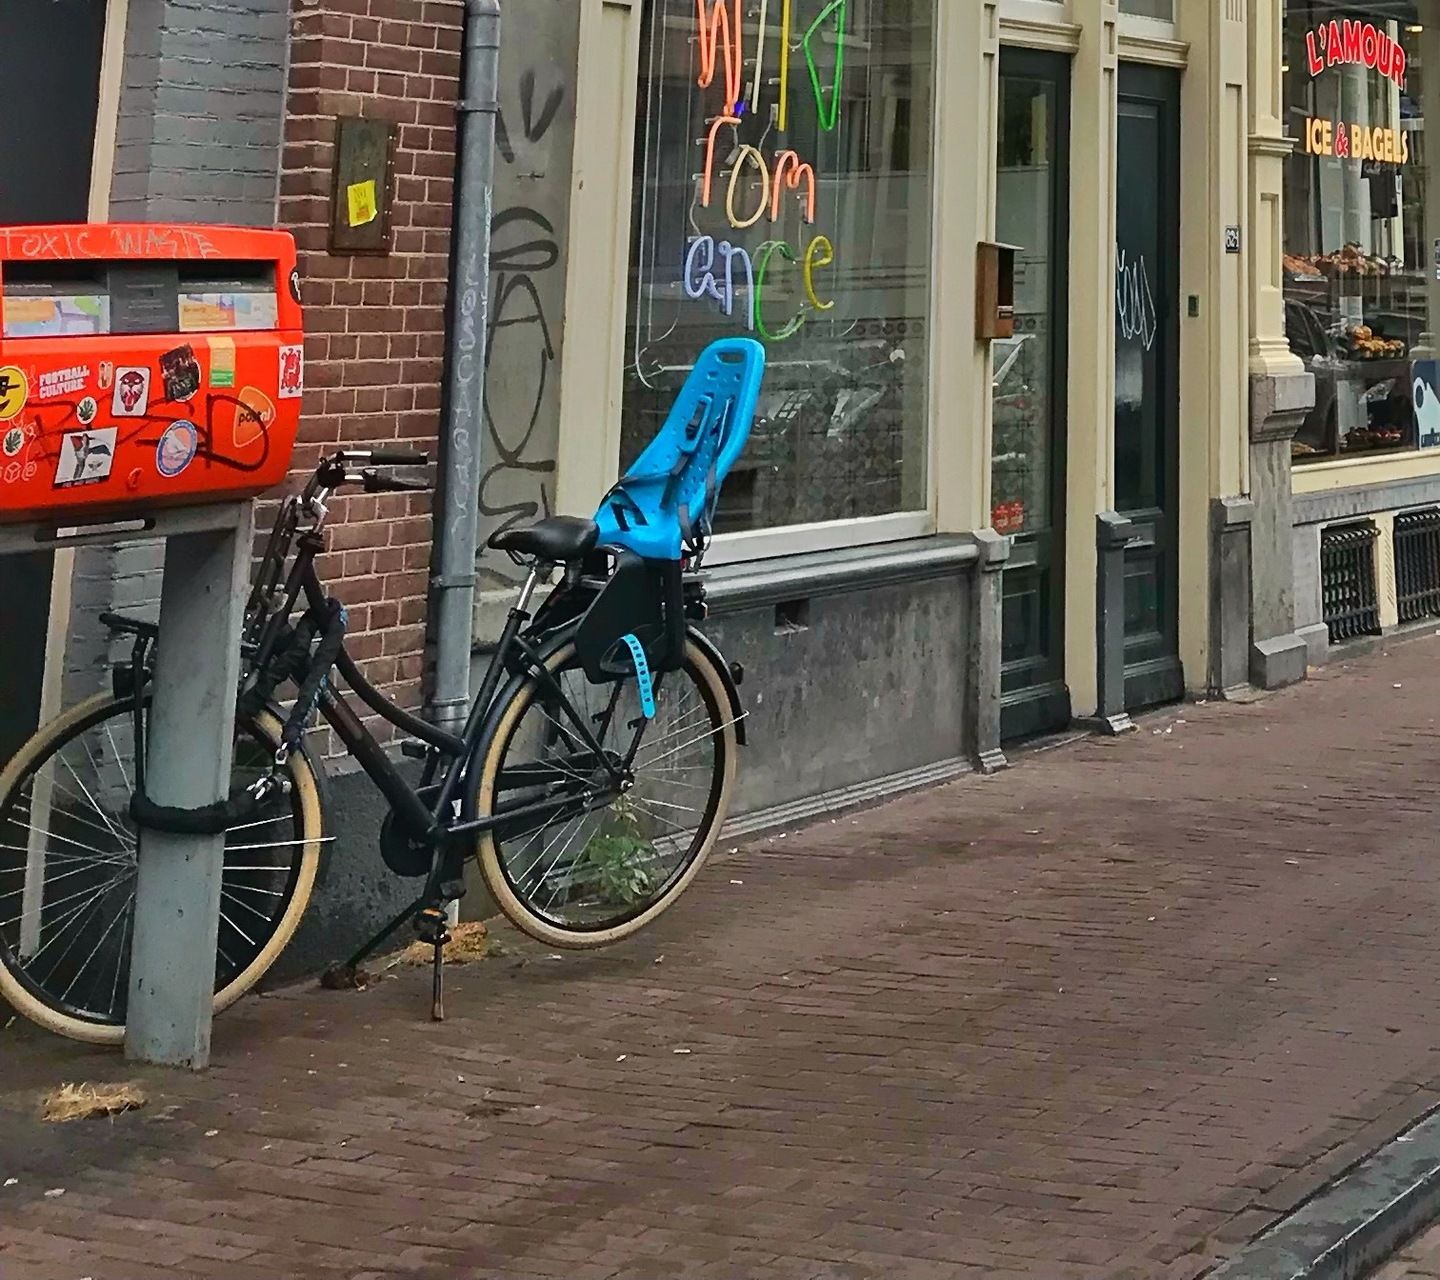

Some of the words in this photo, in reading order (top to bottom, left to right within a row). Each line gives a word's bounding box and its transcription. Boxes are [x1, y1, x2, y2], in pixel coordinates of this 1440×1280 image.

[1306, 19, 1406, 91] L'AMOUR
[1306, 118, 1332, 155] ICE
[1334, 121, 1348, 158] &
[1351, 124, 1408, 164] BAGELS
[0, 230, 101, 259] TOXIC
[110, 228, 222, 259] WASTE
[39, 365, 89, 387] FOOTBALL
